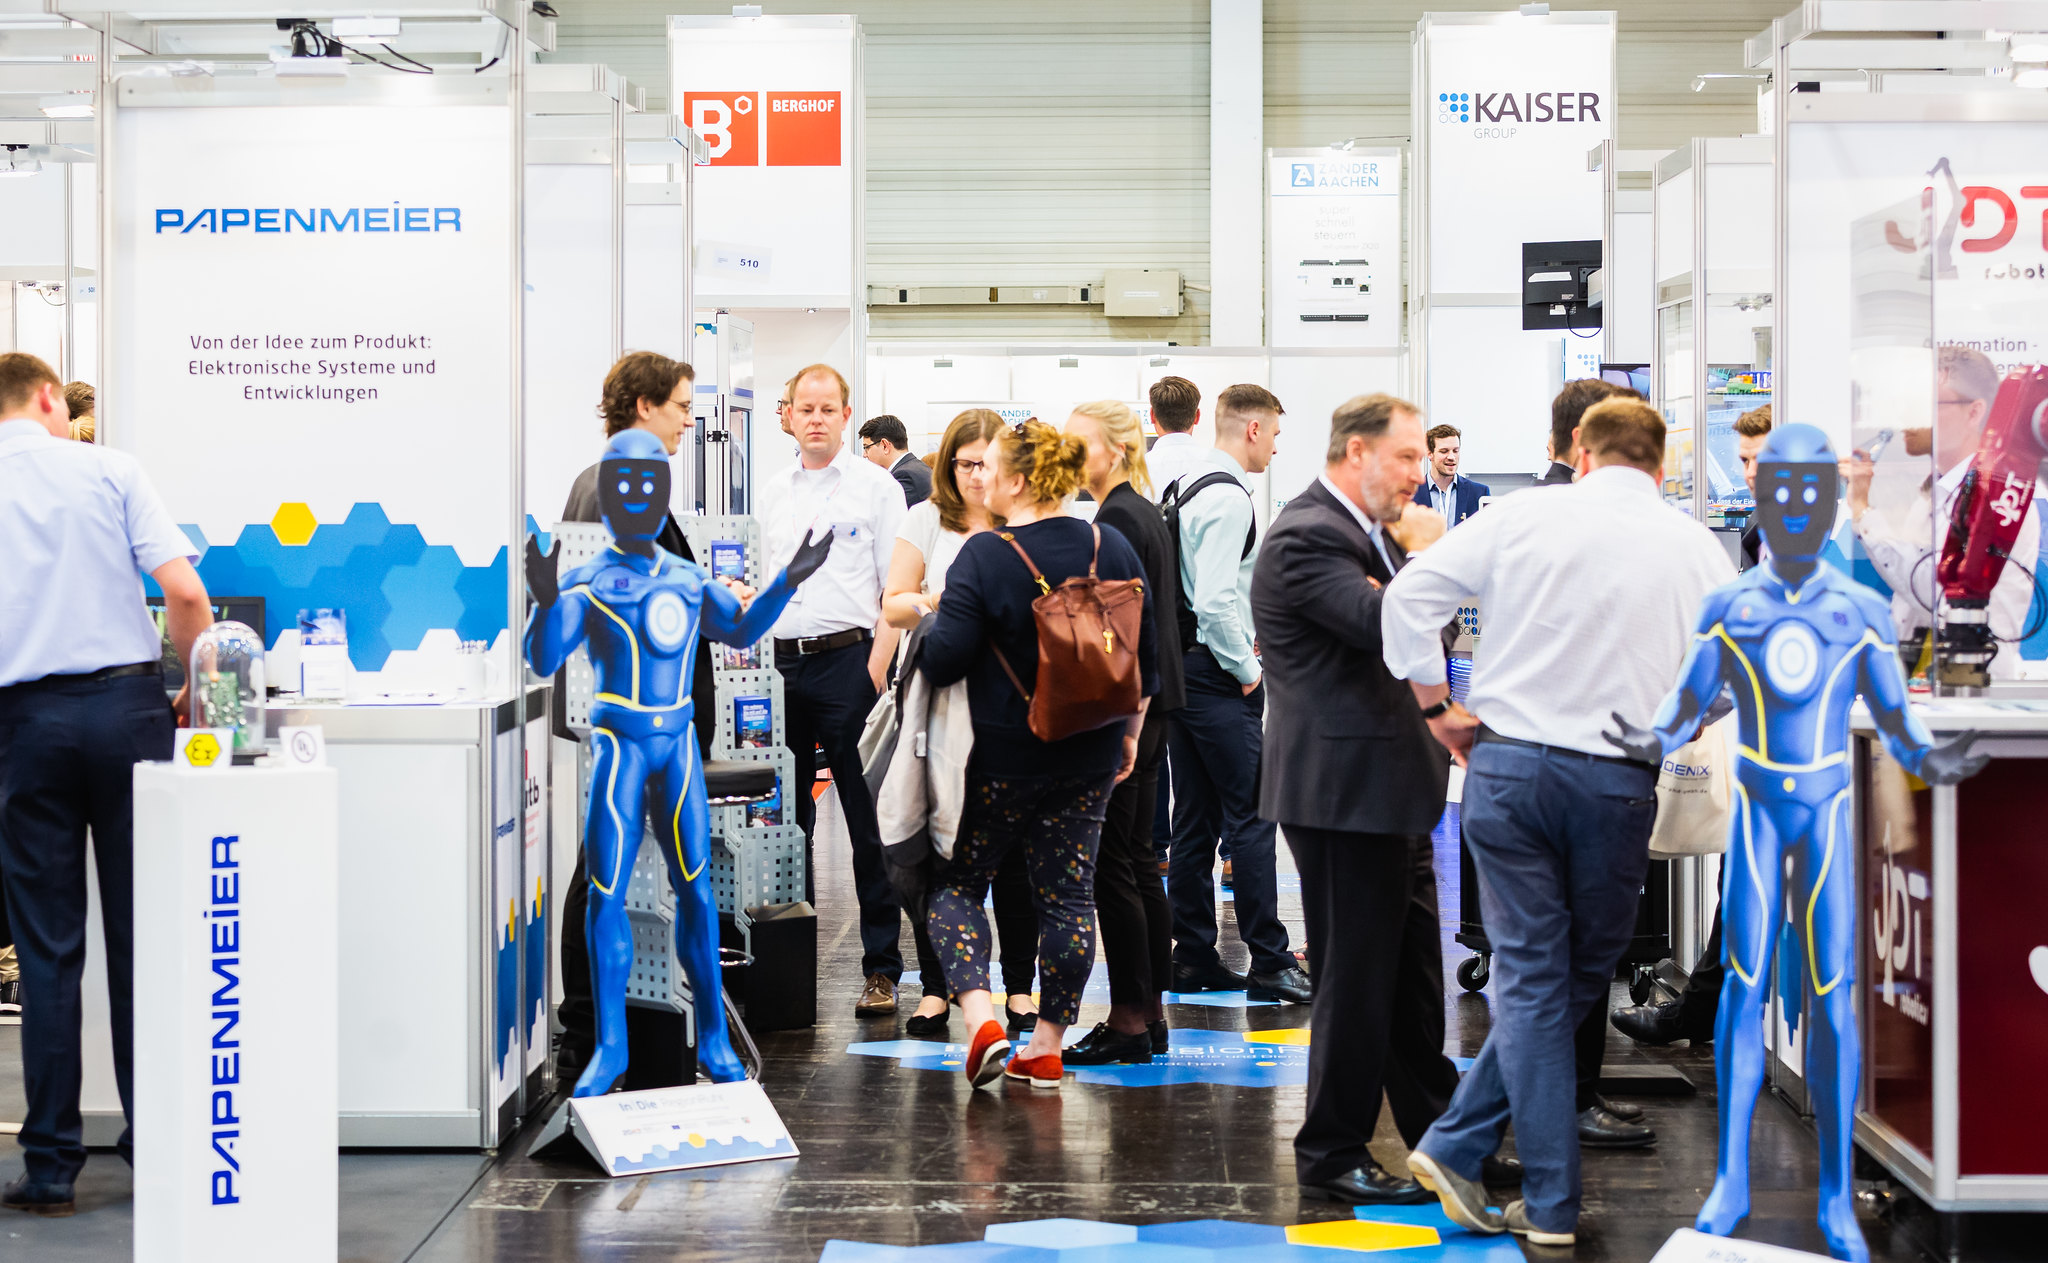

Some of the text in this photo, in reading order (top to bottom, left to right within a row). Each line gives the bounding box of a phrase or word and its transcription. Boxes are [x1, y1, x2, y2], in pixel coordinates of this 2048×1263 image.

[772, 99, 835, 112] BERGHOF
[1475, 92, 1601, 123] KAISER
[1473, 128, 1517, 139] GROUP
[1319, 163, 1378, 174] ZANDER
[1318, 176, 1379, 187] AACHEN
[740, 258, 759, 269] 510
[190, 334, 432, 350] Von der Idee zum Produkt:
[188, 359, 436, 378] Elektronische Systeme und
[243, 385, 379, 403] Entwicklungen
[1661, 760, 1710, 776] OENIX
